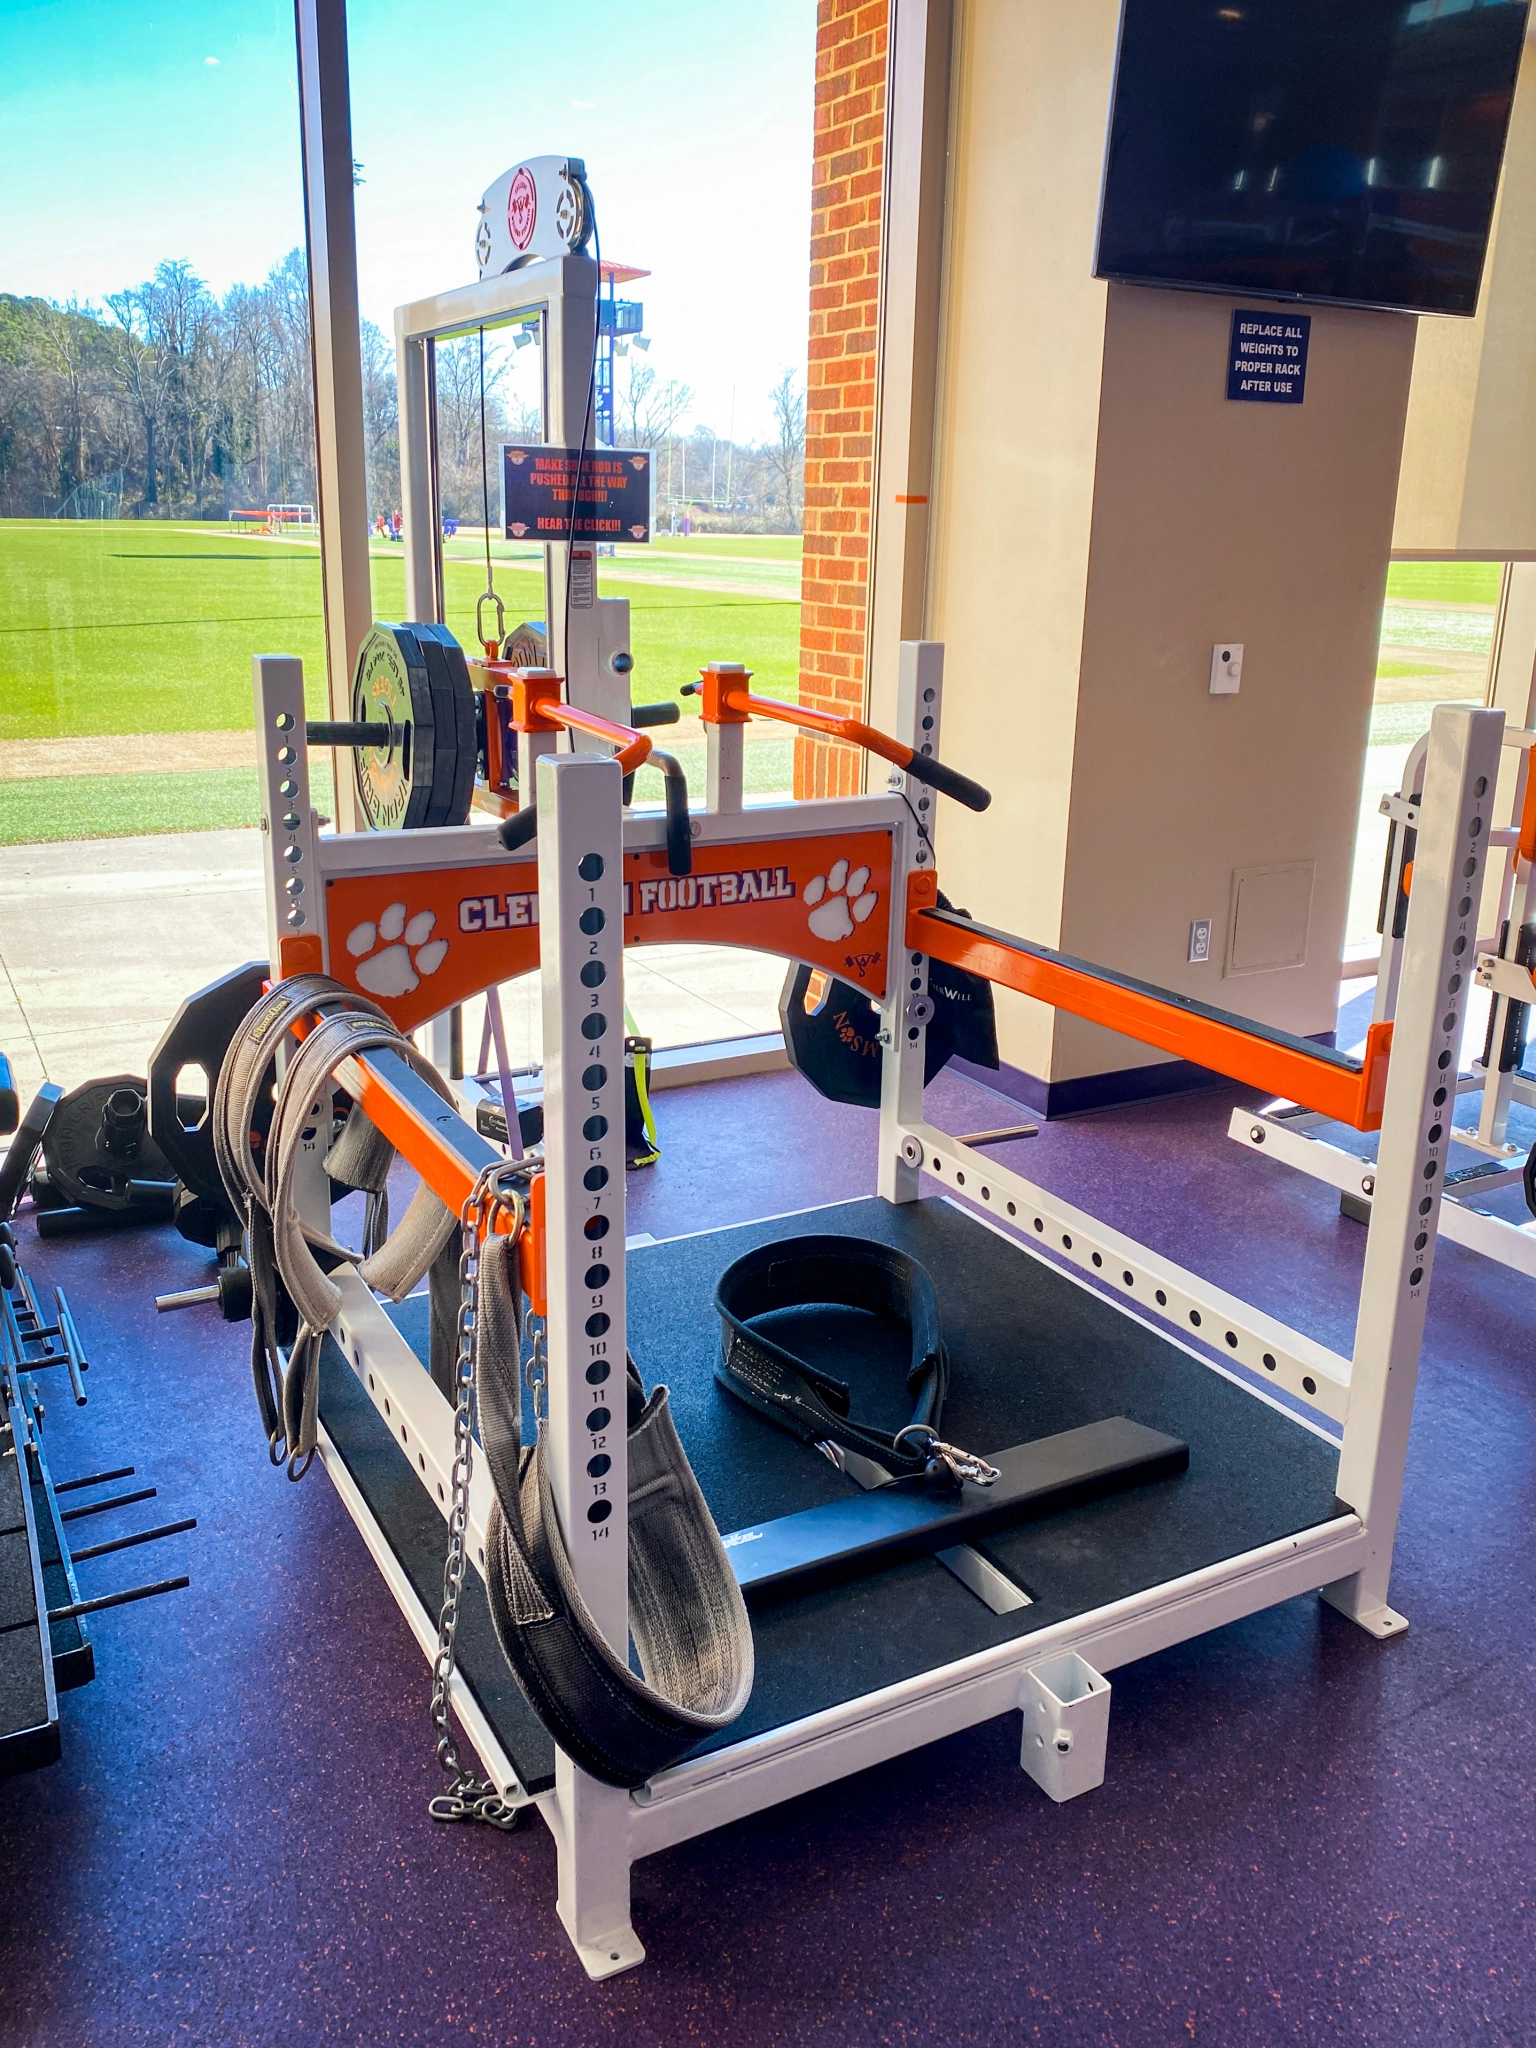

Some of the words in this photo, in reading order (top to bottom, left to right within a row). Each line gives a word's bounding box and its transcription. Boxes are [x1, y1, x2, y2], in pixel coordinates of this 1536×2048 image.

[1240, 323, 1283, 337] REPLACE
[1285, 327, 1302, 338] ALL
[1240, 342, 1283, 355] WEIGHTS
[1286, 345, 1299, 356] TO
[1235, 360, 1272, 374] PROPER
[1275, 363, 1301, 375] RACK
[1240, 380, 1271, 392] AFTER
[1274, 381, 1292, 393] USE
[535, 458, 563, 471] MAKE
[592, 461, 611, 473] ROD
[613, 462, 622, 474] IS
[530, 473, 569, 486] PUSHED
[589, 475, 605, 487] THE
[607, 476, 627, 488] WAY
[537, 517, 562, 530] HEAR
[584, 519, 621, 532] CLICK!!!
[284, 735, 288, 743] 1
[286, 769, 292, 777] 2
[288, 801, 294, 810] 3
[383, 779, 407, 826] IRON
[1476, 803, 1480, 812] 1
[1471, 843, 1476, 853] 2
[292, 867, 298, 875] 5
[640, 866, 796, 914] FOOTBALL
[1465, 883, 1471, 892] 3
[588, 888, 595, 901] 1
[590, 941, 598, 954] 2
[1455, 960, 1460, 970] 5
[591, 994, 599, 1008] 3
[1446, 1036, 1450, 1046] 7
[589, 1046, 600, 1058] 4
[592, 1096, 600, 1110] 5
[303, 1142, 315, 1151] 14
[1428, 1148, 1439, 1157] 10
[590, 1148, 601, 1161] 6
[1425, 1183, 1433, 1192] 11
[593, 1197, 601, 1209] 7
[1419, 1219, 1428, 1228] 12
[592, 1246, 602, 1259] 8
[1416, 1254, 1424, 1264] 13
[592, 1295, 603, 1308] 9
[590, 1342, 606, 1356] 10
[592, 1390, 605, 1403] 11
[592, 1436, 606, 1449] 12
[593, 1482, 606, 1495] 13
[591, 1528, 609, 1541] 14
